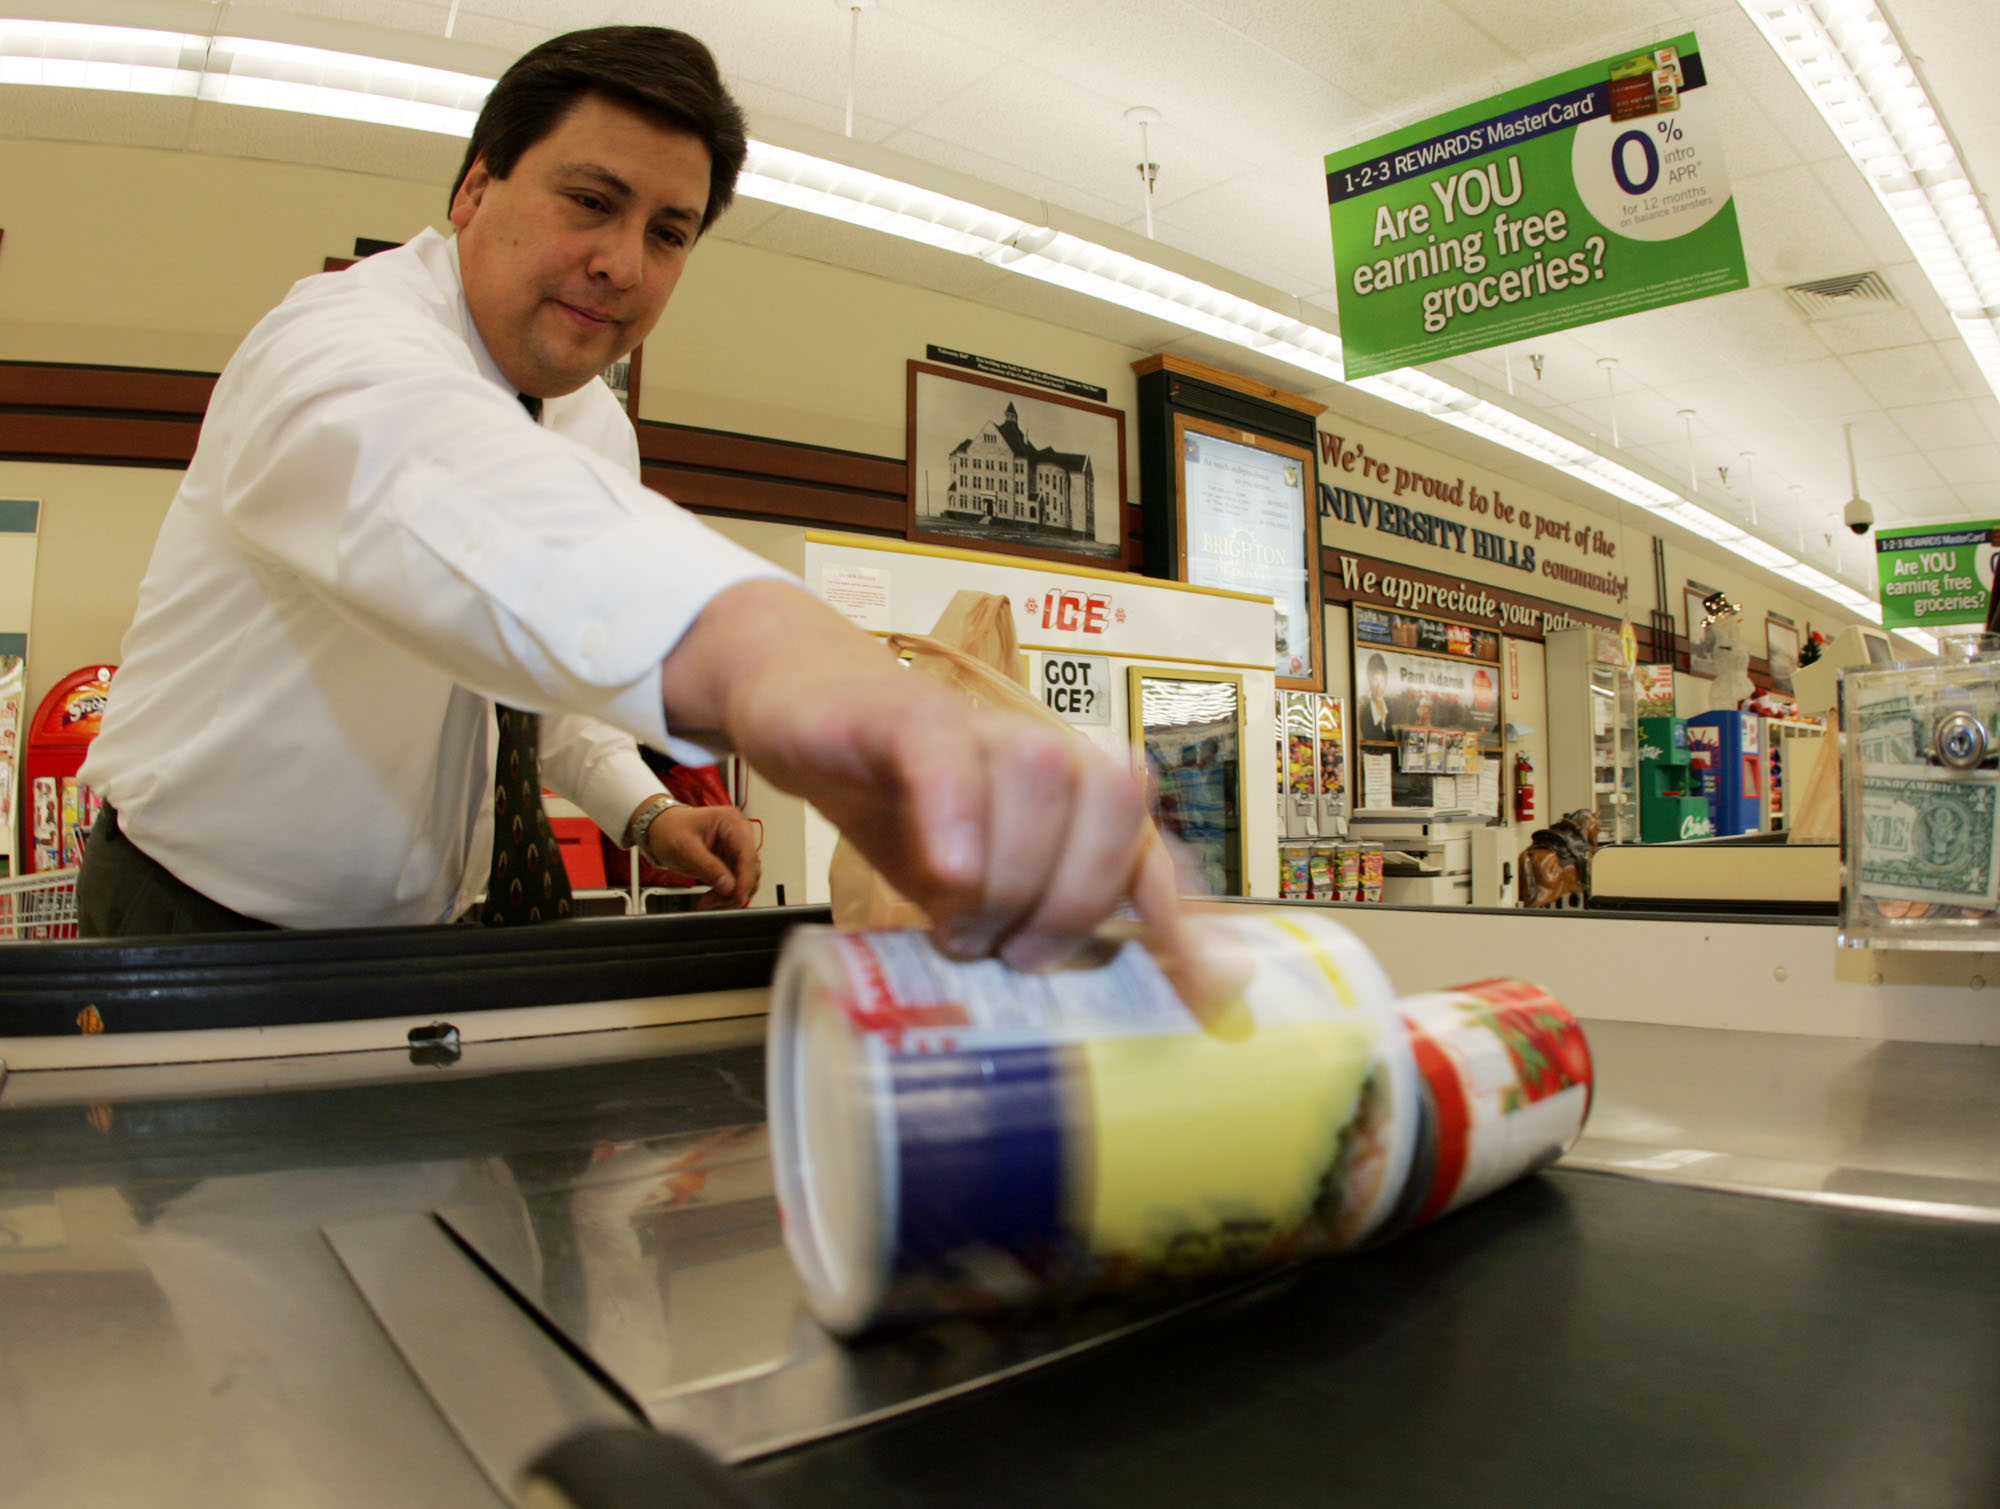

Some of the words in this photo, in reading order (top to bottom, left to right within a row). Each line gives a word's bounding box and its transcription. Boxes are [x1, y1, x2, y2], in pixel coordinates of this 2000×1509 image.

[1664, 146, 1695, 164] intro
[1345, 161, 1391, 192] 1-2-3
[1373, 203, 1432, 247] Are
[1431, 156, 1524, 224] YOU
[1620, 218, 1631, 228] on
[1634, 206, 1670, 224] balance
[1672, 196, 1712, 214] transfers
[1622, 204, 1638, 217] for
[1644, 198, 1658, 211] 12
[1662, 185, 1706, 205] months
[1354, 231, 1488, 296] earning
[1494, 209, 1568, 256] free
[1423, 235, 1607, 333] groceries?
[1318, 430, 1390, 484] We're
[1393, 466, 1464, 507] proud
[1469, 486, 1489, 514] to
[1493, 490, 1514, 524] be
[1519, 510, 1532, 529] a
[1534, 515, 1571, 543] part
[1574, 525, 1591, 555] of
[1593, 530, 1615, 558] the
[1203, 532, 1288, 566] BRIGHTON
[1318, 482, 1467, 553] NIVERSITY
[1471, 528, 1536, 573] HILLS
[1542, 559, 1629, 604] community!
[1894, 558, 1919, 576] Are
[1919, 551, 1957, 573] YOU
[1339, 556, 1376, 594] We
[1381, 575, 1496, 618] appreciate
[1499, 600, 1540, 627] your
[1886, 576, 1941, 596] earning
[1944, 574, 1972, 591] free
[1042, 588, 1112, 634] ICE
[1914, 591, 1986, 616] groceries?
[1045, 660, 1092, 686] GOT
[1046, 687, 1095, 714] ICE?
